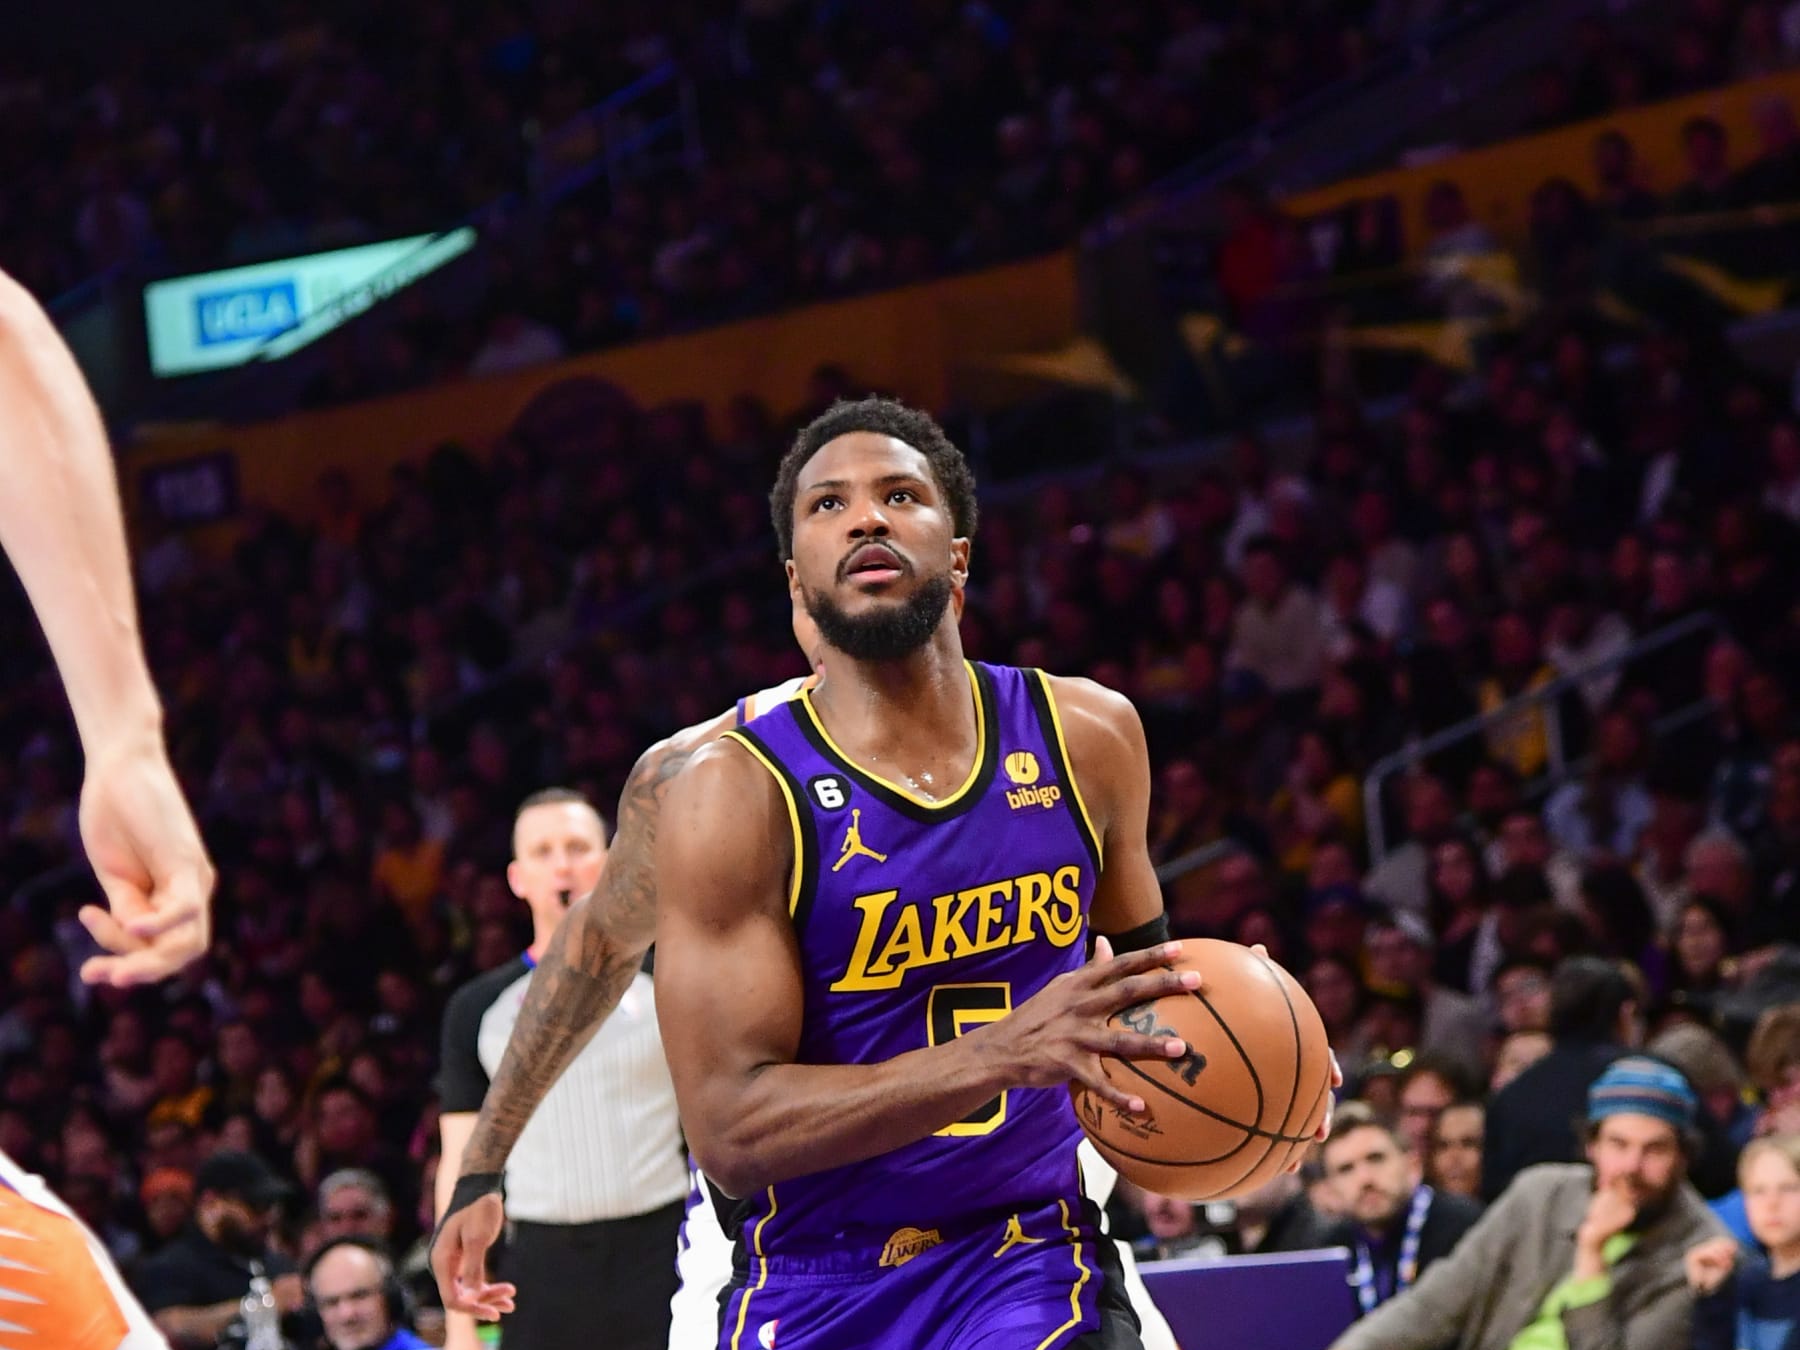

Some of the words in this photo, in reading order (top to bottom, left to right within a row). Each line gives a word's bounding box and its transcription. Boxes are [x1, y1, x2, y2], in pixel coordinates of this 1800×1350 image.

[813, 778, 845, 809] 6
[1006, 783, 1061, 810] bibigo
[829, 865, 1083, 993] LAKERS
